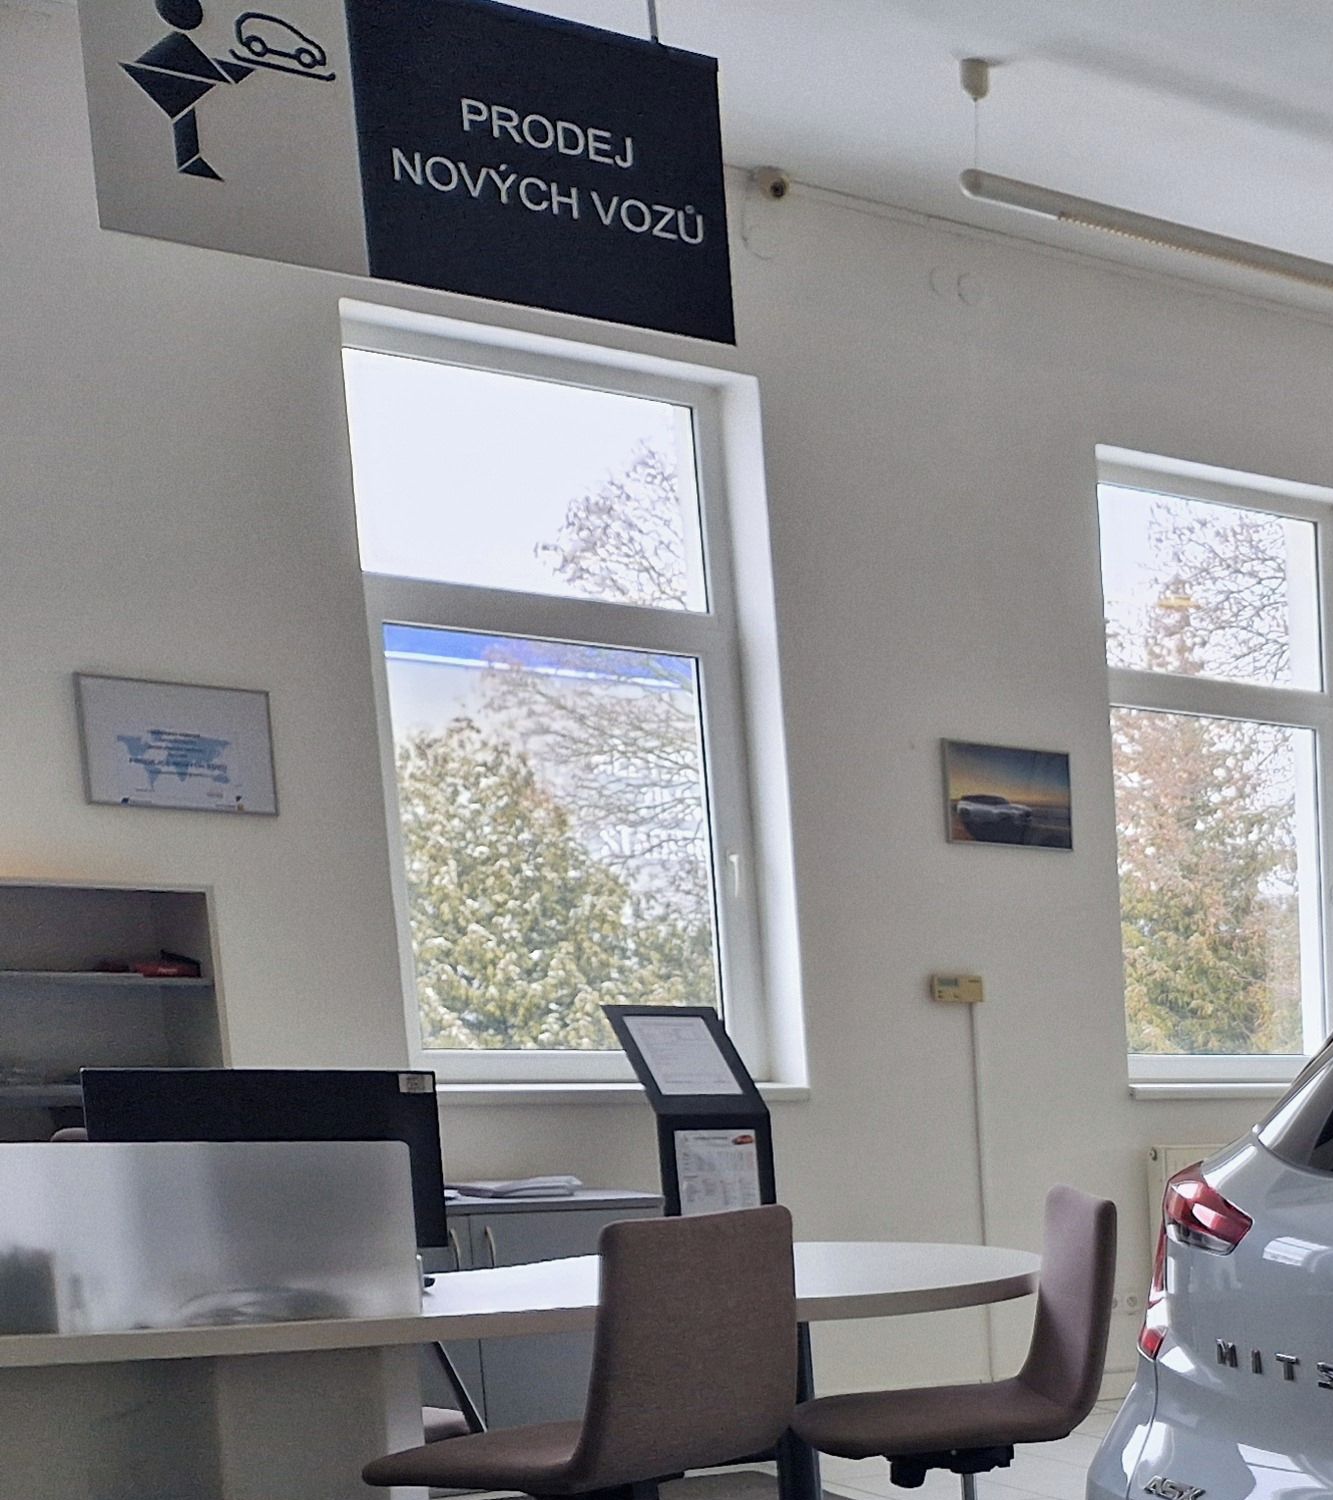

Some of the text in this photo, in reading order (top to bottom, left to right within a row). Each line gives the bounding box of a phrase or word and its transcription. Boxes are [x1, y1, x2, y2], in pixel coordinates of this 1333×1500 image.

[461, 97, 634, 169] PRODEJ
[392, 147, 705, 245] NOVÝCH VOZŮ
